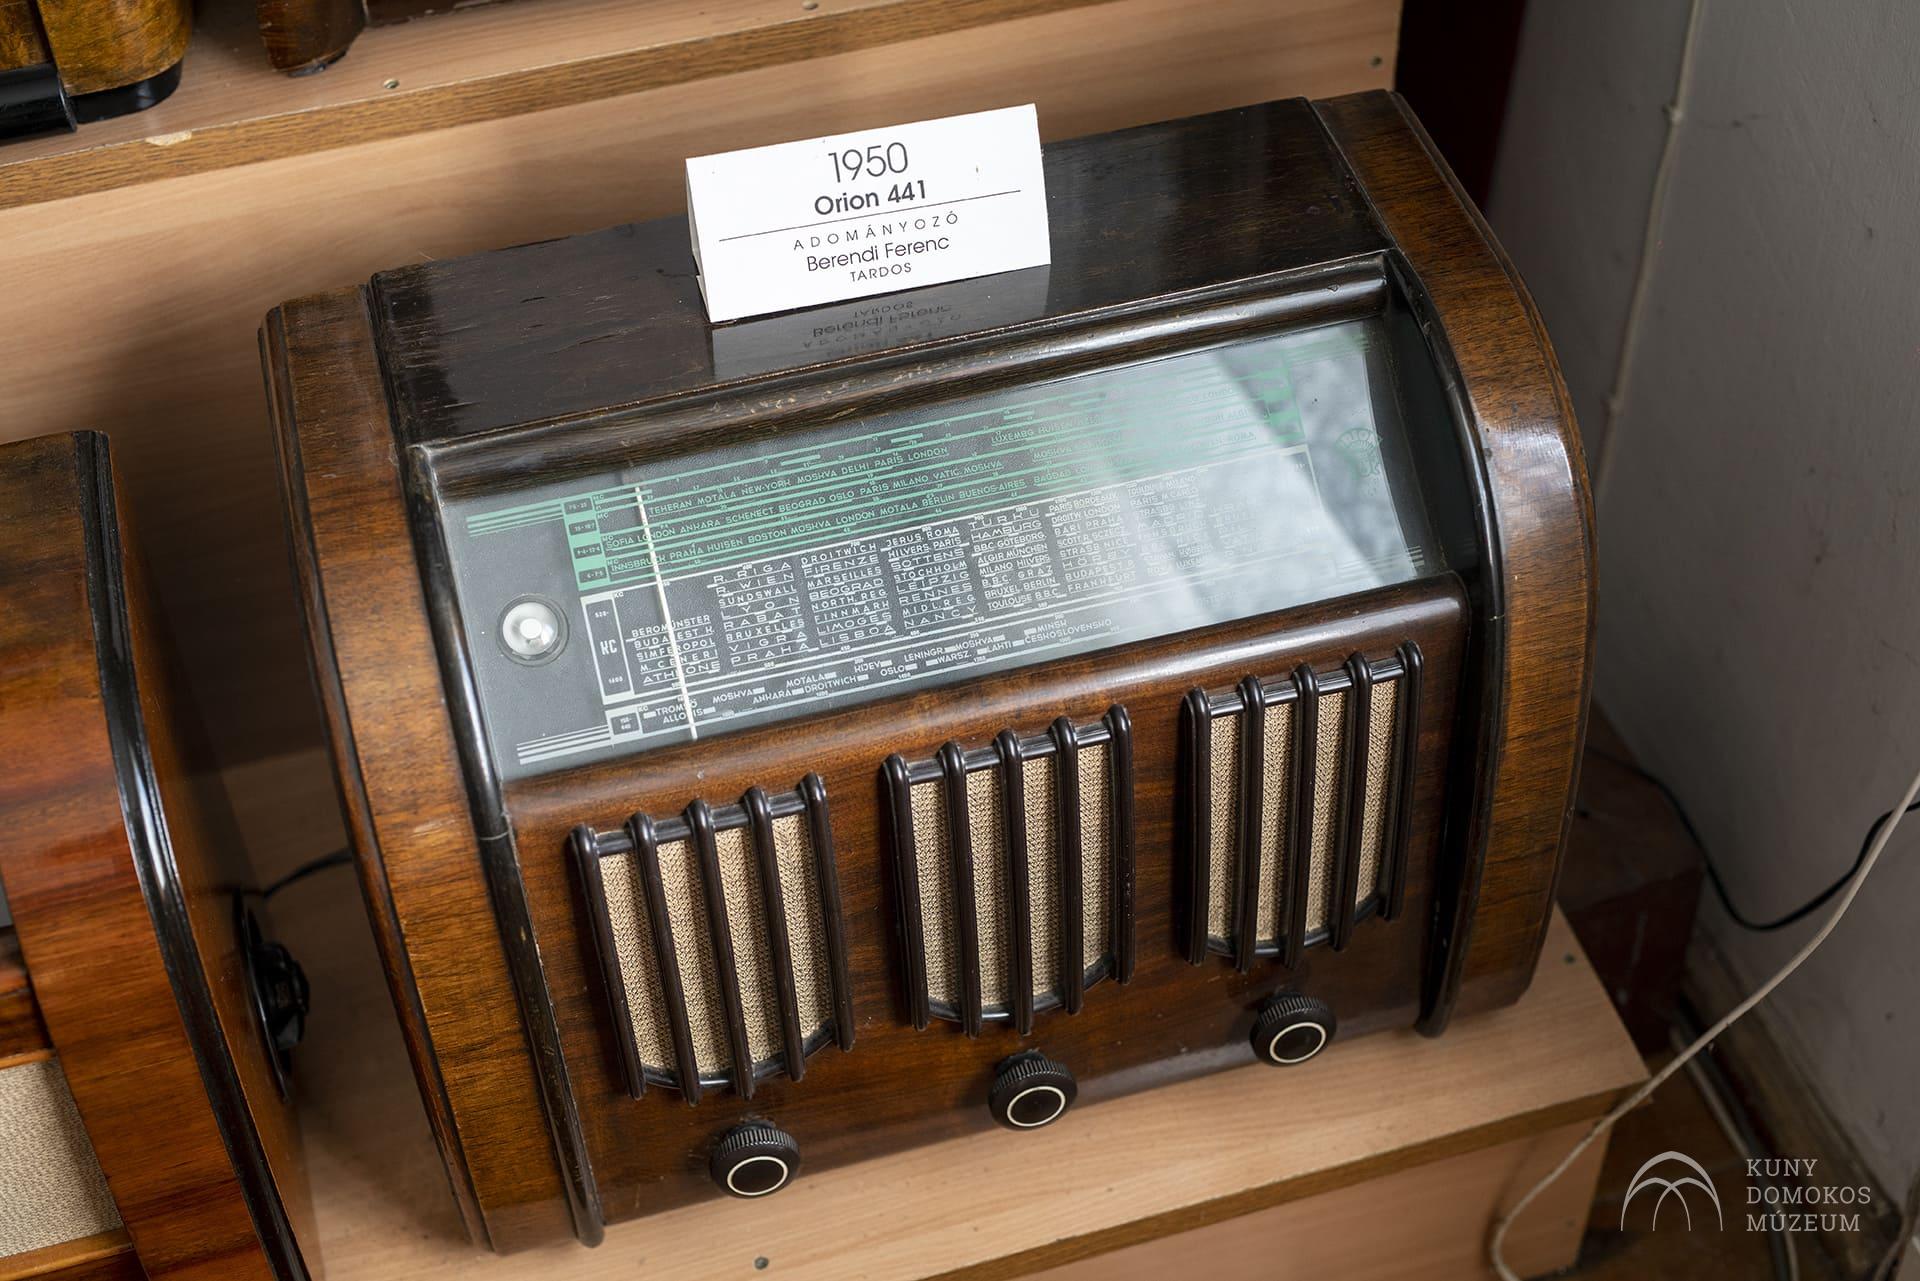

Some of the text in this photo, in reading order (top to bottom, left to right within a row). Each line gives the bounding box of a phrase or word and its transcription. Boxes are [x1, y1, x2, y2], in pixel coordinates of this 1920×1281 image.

[828, 142, 908, 182] 1950
[814, 180, 926, 215] Orion 441
[794, 210, 958, 250] ADOMÁNYOZÓ
[807, 235, 950, 272] Berendi Ferenc
[851, 262, 912, 282] TARDOS
[647, 445, 948, 515] TEHERAN MOTALA NEW-YORK MOSKVA DELHI PARIS LONDON
[605, 536, 635, 548] SOFIA
[678, 518, 721, 533] ANKARA
[777, 496, 826, 512] BEOGRAD
[827, 490, 855, 502] OSLO
[858, 482, 889, 495] PARIS
[891, 474, 929, 488] MILANO
[668, 546, 704, 560] PRAHA
[706, 538, 743, 552] HUISEN
[747, 529, 787, 543] BOSTON
[789, 520, 831, 534] MOSKVA
[834, 510, 876, 524] LONDON
[878, 501, 918, 515] MOTALA
[921, 493, 955, 506] BERLIN
[958, 478, 1026, 499] BUENOS-AIRES
[967, 508, 1039, 529] TURKU
[885, 526, 959, 546] JERUS. ROMA
[970, 520, 1042, 540] HAMBURG
[932, 537, 961, 548] PARIS
[800, 543, 876, 564] DROITWICH
[890, 548, 964, 569] SOTTENS
[712, 561, 790, 584] R. RIGA
[803, 554, 879, 575] FIRENZE
[893, 560, 967, 581] STOCKHOLM
[978, 561, 1014, 574] MILANO
[1016, 565, 1053, 578] GRAZ
[715, 572, 794, 594] R. WIEN
[806, 566, 882, 587] MARSEILLES
[895, 571, 970, 592] LEIPZIG
[1022, 576, 1056, 589] BERLIN
[717, 584, 796, 606] SUNDSWALL
[808, 578, 884, 599] BEOGRAD
[898, 582, 972, 603] RENNES
[720, 596, 799, 618] LYON
[814, 600, 889, 621] FINNMARK
[986, 593, 1033, 610] TOULOUSE
[722, 607, 802, 628] RABAT
[816, 612, 893, 634] LIMOGES
[903, 606, 978, 627] NANCY
[1034, 620, 1068, 632] MINSK
[633, 628, 700, 648] BUDAEST
[725, 618, 805, 640] BRUXELLES
[818, 624, 895, 645] LISBOA
[598, 638, 618, 656] KC
[636, 637, 716, 660] SIMFEROPOL
[728, 631, 806, 652] VIGRA
[955, 636, 994, 650] MOSKVA
[985, 641, 1012, 652] LAHTI
[656, 649, 718, 667] CENERI
[730, 642, 809, 664] PRAHA
[936, 650, 972, 663] WARSZ.
[784, 672, 825, 686] MOTALA
[880, 665, 906, 676] OSLO
[804, 676, 857, 692] DROITWICH
[711, 688, 753, 702] MOSKVA
[751, 690, 793, 703] ANKARA
[655, 699, 698, 715] TROMÖ
[661, 708, 704, 723] ALLOIS
